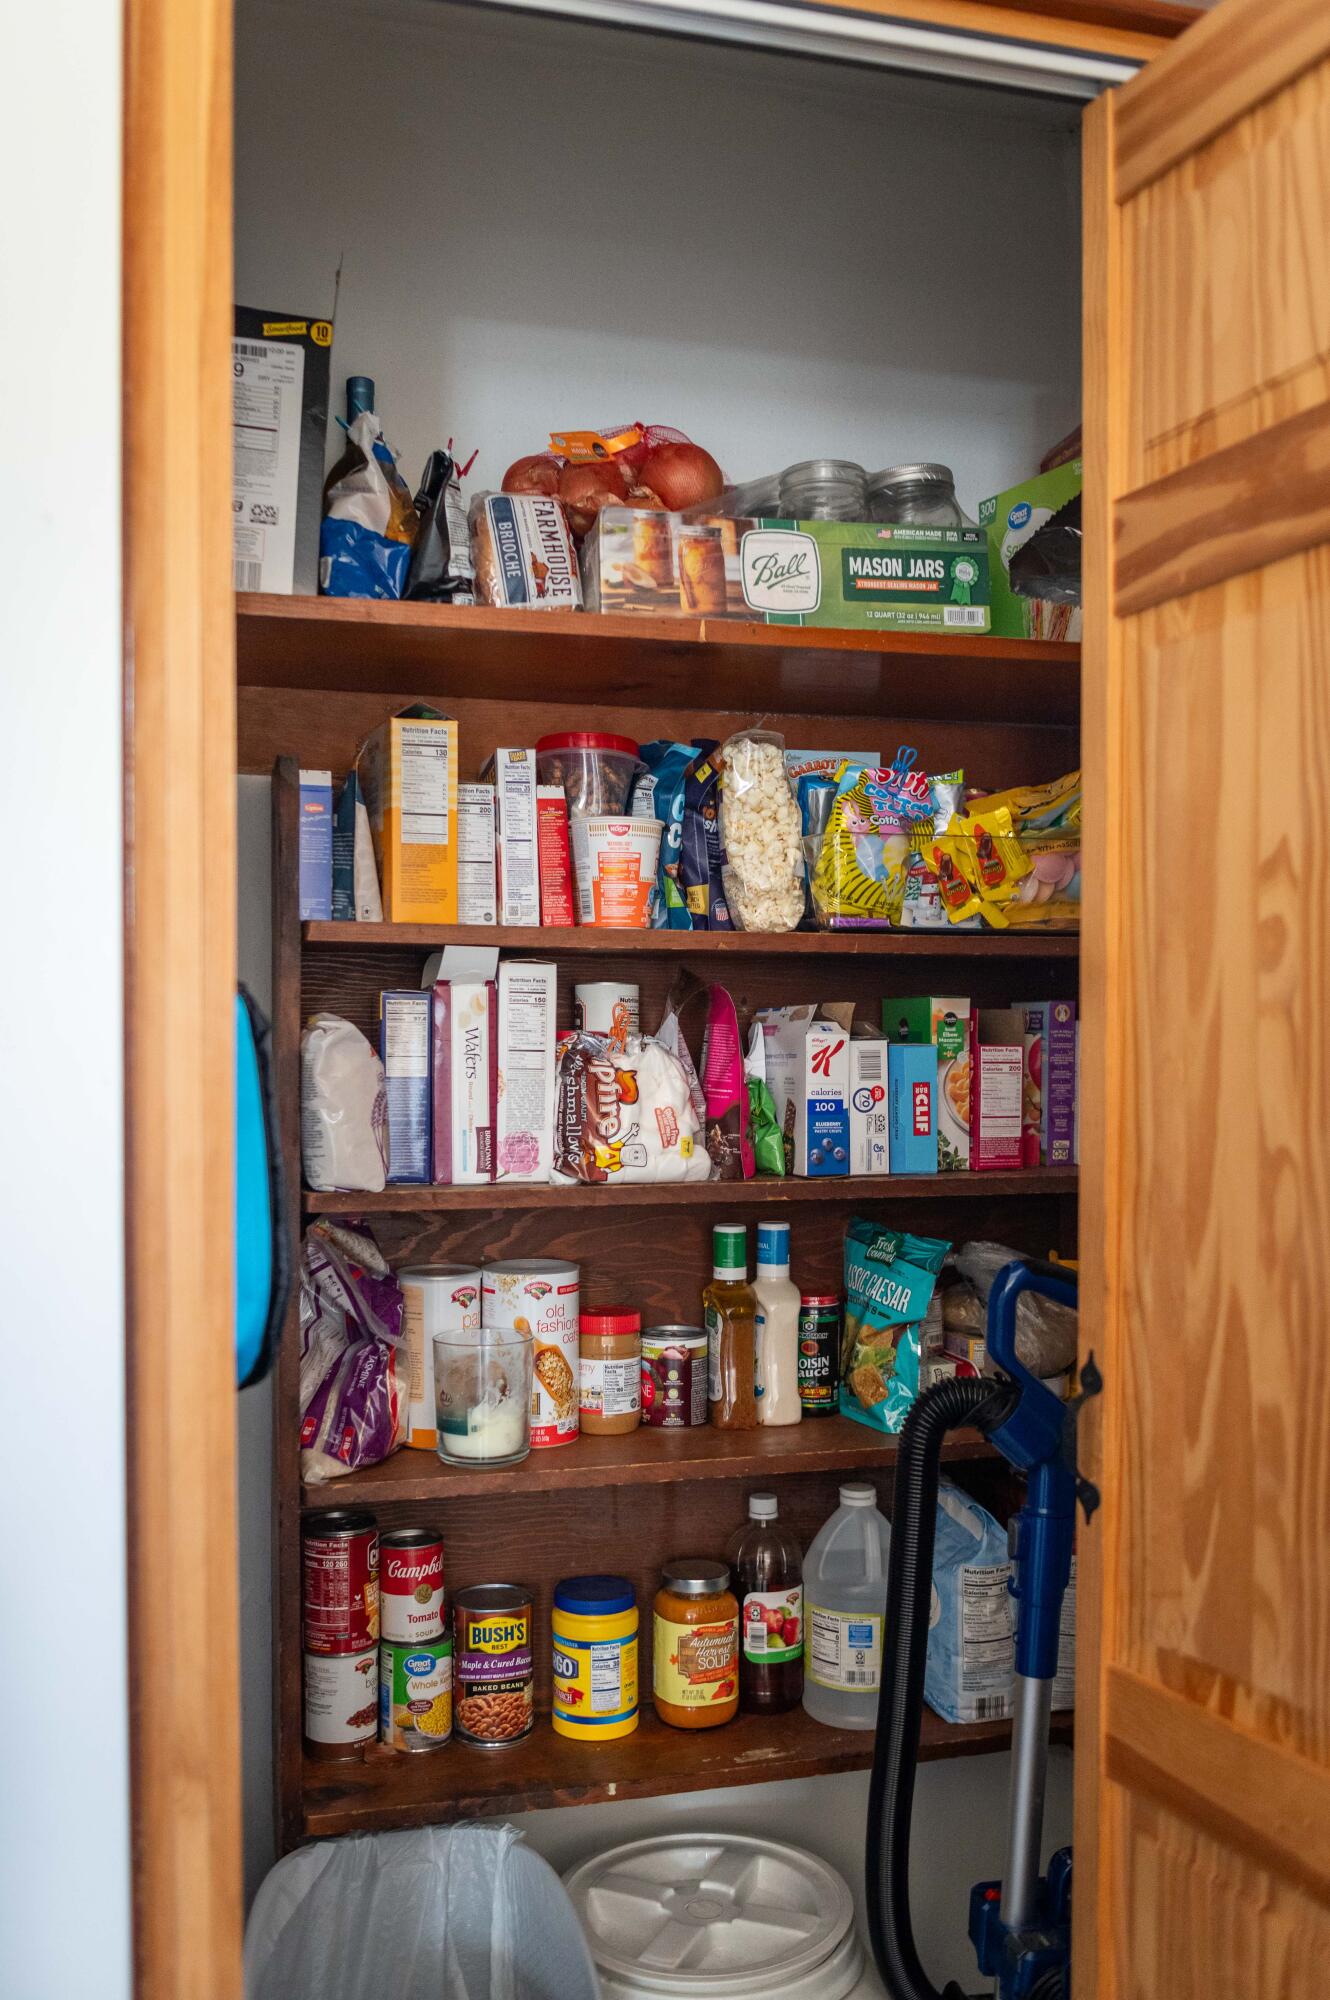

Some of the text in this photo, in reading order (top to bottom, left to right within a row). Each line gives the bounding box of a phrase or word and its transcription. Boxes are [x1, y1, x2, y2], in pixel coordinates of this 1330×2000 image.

[315, 325, 328, 337] 10
[980, 499, 997, 518] 300
[498, 521, 522, 579] BRIOCHE
[533, 500, 572, 597] FARMHOUSE
[752, 552, 810, 588] Ball
[849, 556, 945, 578] MASON JARS
[857, 580, 886, 588] STRONGEST
[887, 581, 906, 589] SEALING
[927, 582, 937, 590] JAR
[897, 612, 906, 620] (32
[430, 728, 448, 736] Facts
[435, 749, 448, 757] 130
[790, 760, 837, 780] CARROT
[870, 814, 899, 827] Cotto
[464, 1027, 482, 1079] Wafers
[811, 1039, 845, 1077] K
[811, 1087, 842, 1096] calories
[815, 1102, 836, 1112] 100
[862, 1094, 871, 1108] 70
[915, 1094, 929, 1132] CLIF
[875, 1236, 897, 1253] Fresh
[866, 1244, 898, 1263] Gourmet
[865, 1273, 912, 1314] CAESAR
[546, 1303, 565, 1319] old
[537, 1317, 577, 1334] fashion
[799, 1355, 830, 1370] OISIN
[358, 1354, 380, 1389] JASMINE
[798, 1367, 830, 1378] auce
[329, 1541, 349, 1549] Facts
[322, 1560, 334, 1568] 120
[335, 1560, 348, 1568] 260
[964, 1568, 995, 1576] Nutrition
[407, 1610, 439, 1624] Tomato
[472, 1622, 525, 1645] BUSH'S
[690, 1631, 735, 1648] Autumnal
[695, 1644, 732, 1657] Harvest
[407, 1659, 432, 1669] Great
[461, 1660, 482, 1671] Maple
[483, 1661, 490, 1669] &
[490, 1658, 515, 1668] Cured
[553, 1650, 573, 1677] RGO
[698, 1653, 731, 1670] SOUP
[411, 1679, 438, 1691] Whole
[472, 1681, 524, 1692] BAKED BEANS
